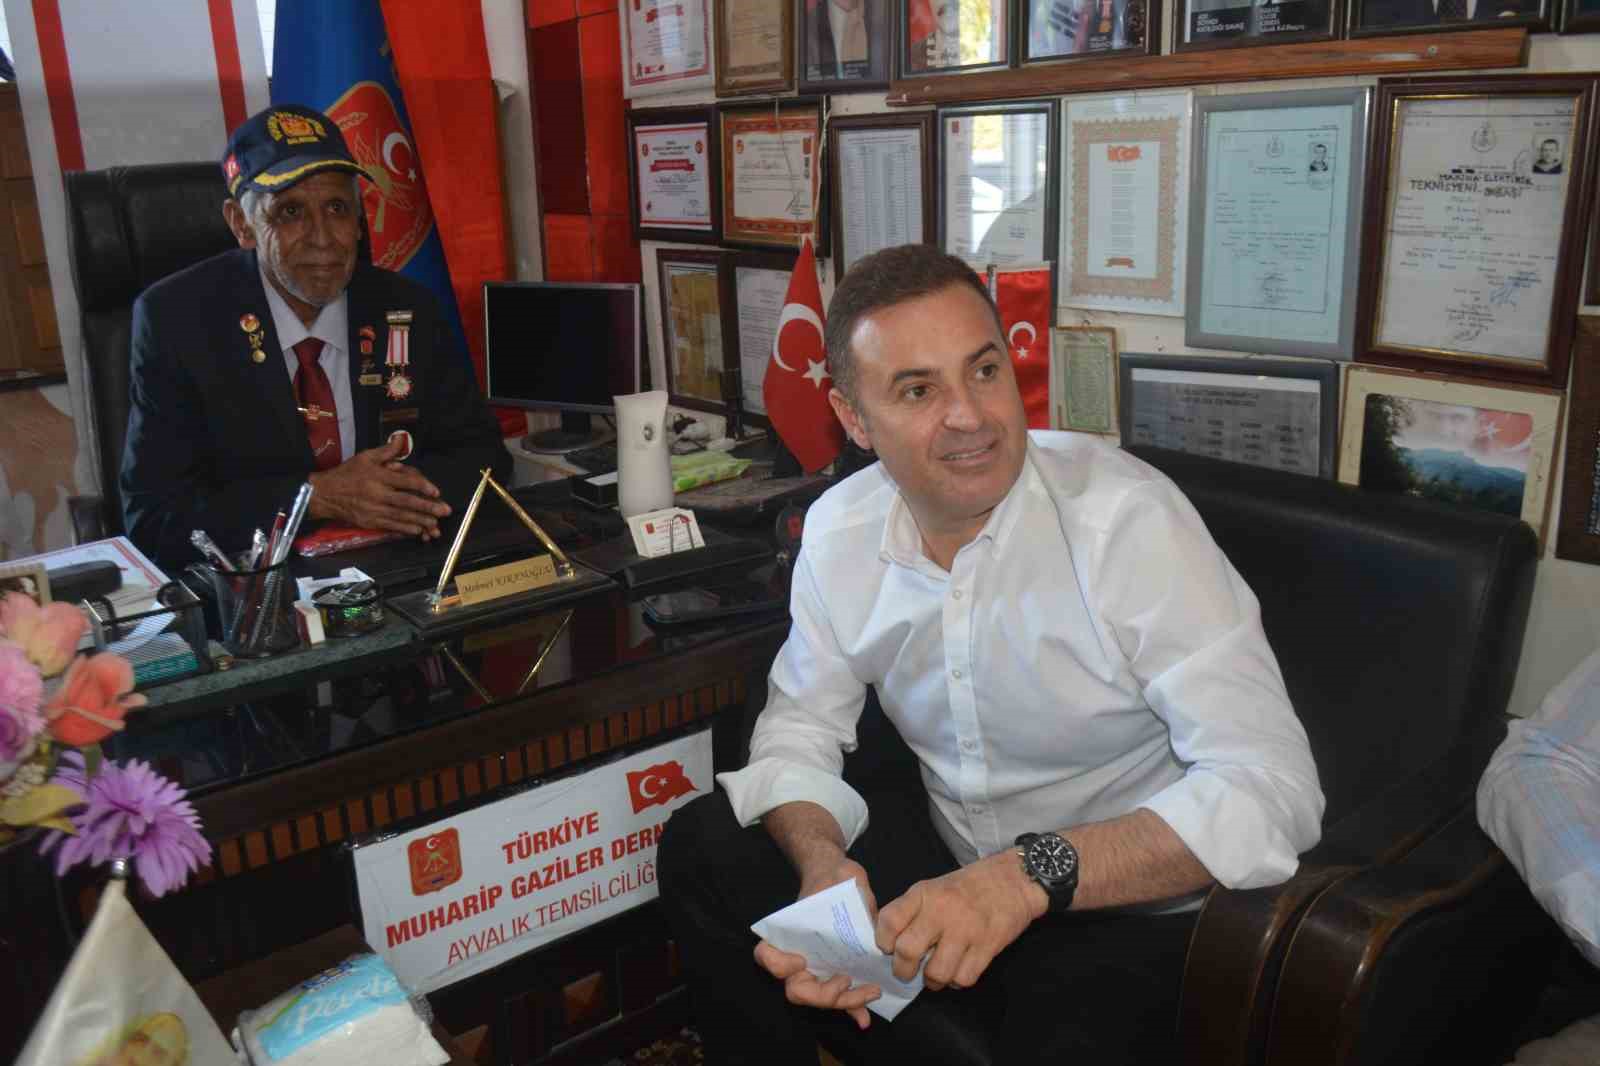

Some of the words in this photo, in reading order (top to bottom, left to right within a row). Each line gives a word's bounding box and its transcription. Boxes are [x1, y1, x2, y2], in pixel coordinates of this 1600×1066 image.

[502, 811, 599, 864] TÜRKİYE
[386, 885, 503, 948] MUHARİP
[511, 842, 604, 899] GAZİLER
[447, 913, 531, 965] AYVALIK
